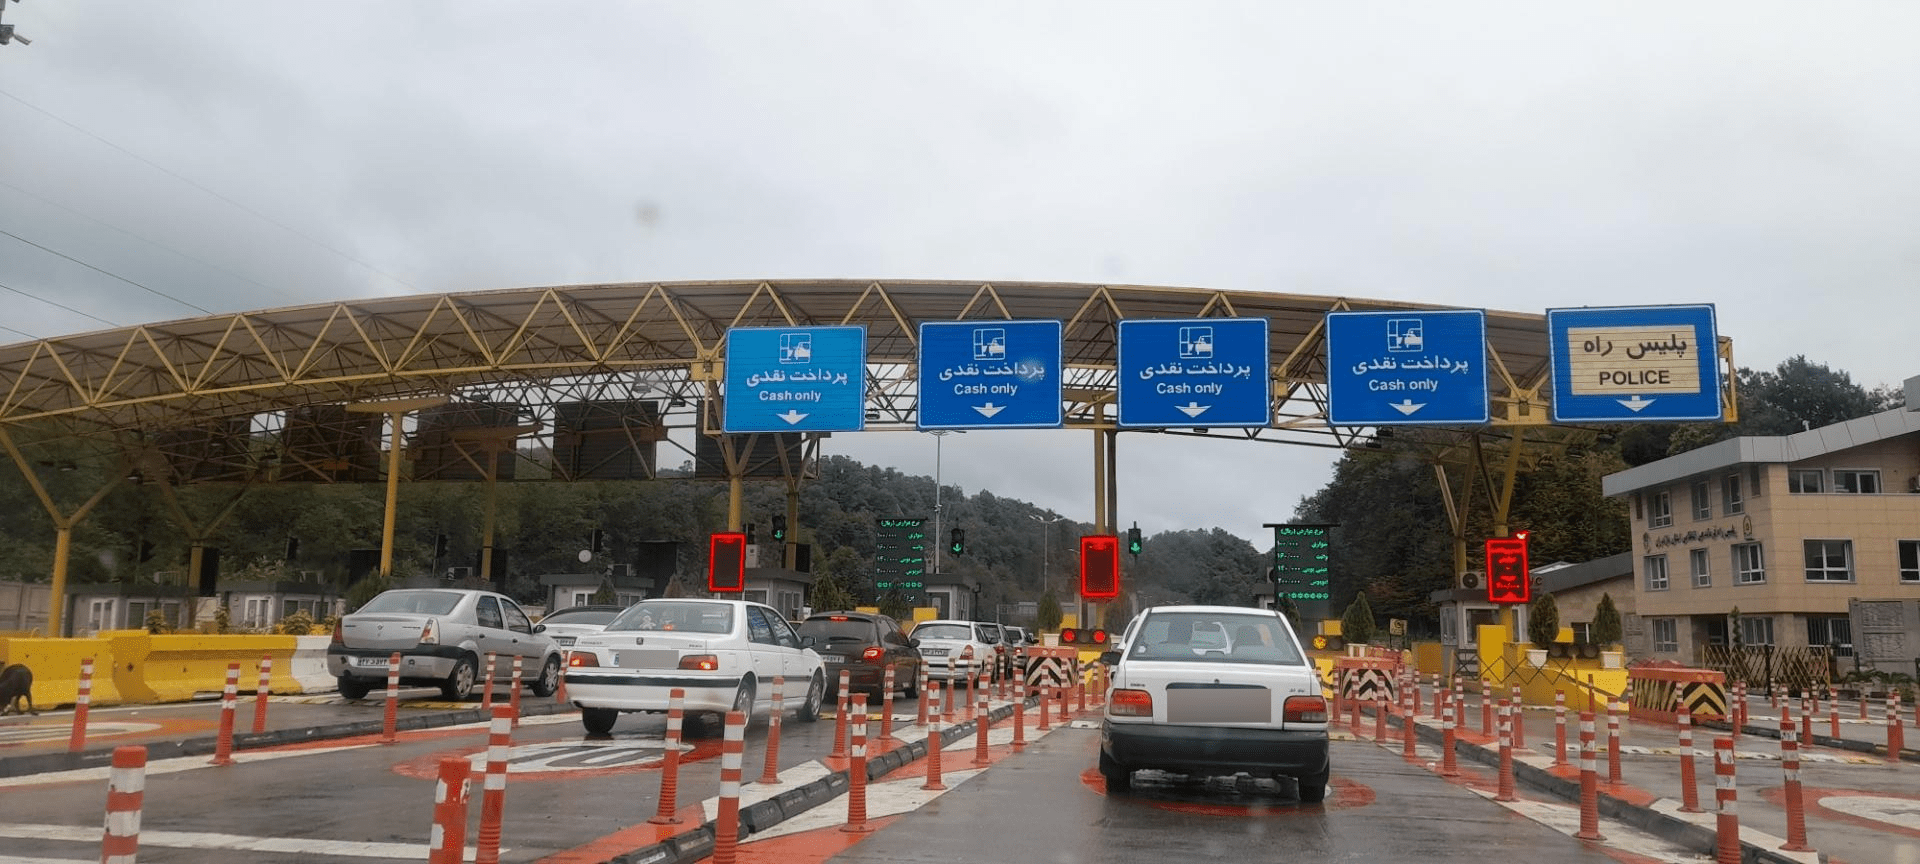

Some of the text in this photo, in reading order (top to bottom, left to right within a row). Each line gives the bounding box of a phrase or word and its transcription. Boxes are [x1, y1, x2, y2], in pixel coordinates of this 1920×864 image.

[1583, 333, 1687, 360] پلیس راه
[939, 362, 1045, 381] پرداخت نقدی
[1139, 361, 1251, 380] پرداخت نقدی
[1352, 354, 1469, 375] پرداخت نقدی
[746, 368, 848, 387] پرداخت نقدی
[1368, 378, 1438, 392] Cash only
[1599, 370, 1671, 386] POLICE
[759, 390, 822, 402] Cash only
[954, 383, 1018, 397] Cash only
[1156, 382, 1223, 396] Cash only
